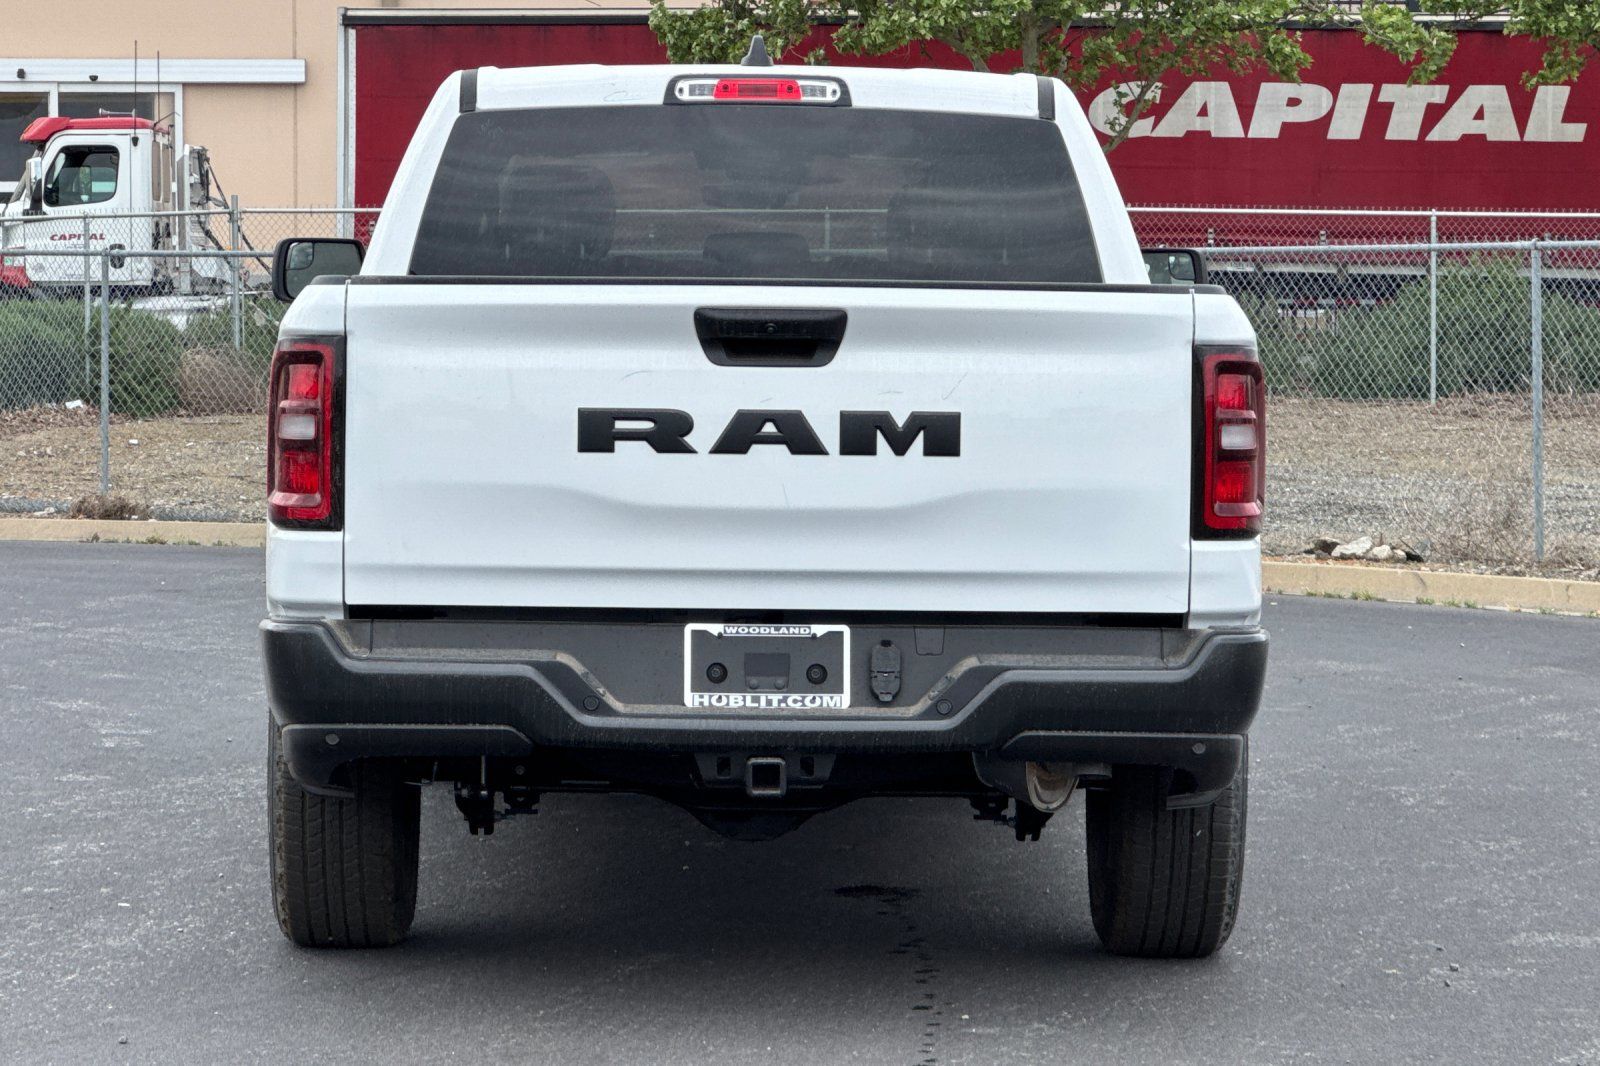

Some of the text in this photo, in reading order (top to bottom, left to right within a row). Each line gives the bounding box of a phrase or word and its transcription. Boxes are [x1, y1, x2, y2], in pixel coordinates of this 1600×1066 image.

[1088, 81, 1588, 142] CAPITAL
[50, 233, 106, 241] CAPIAL
[577, 408, 961, 457] RAM
[725, 626, 810, 635] WOODLAND
[692, 694, 842, 707] HOBLIT.COM
